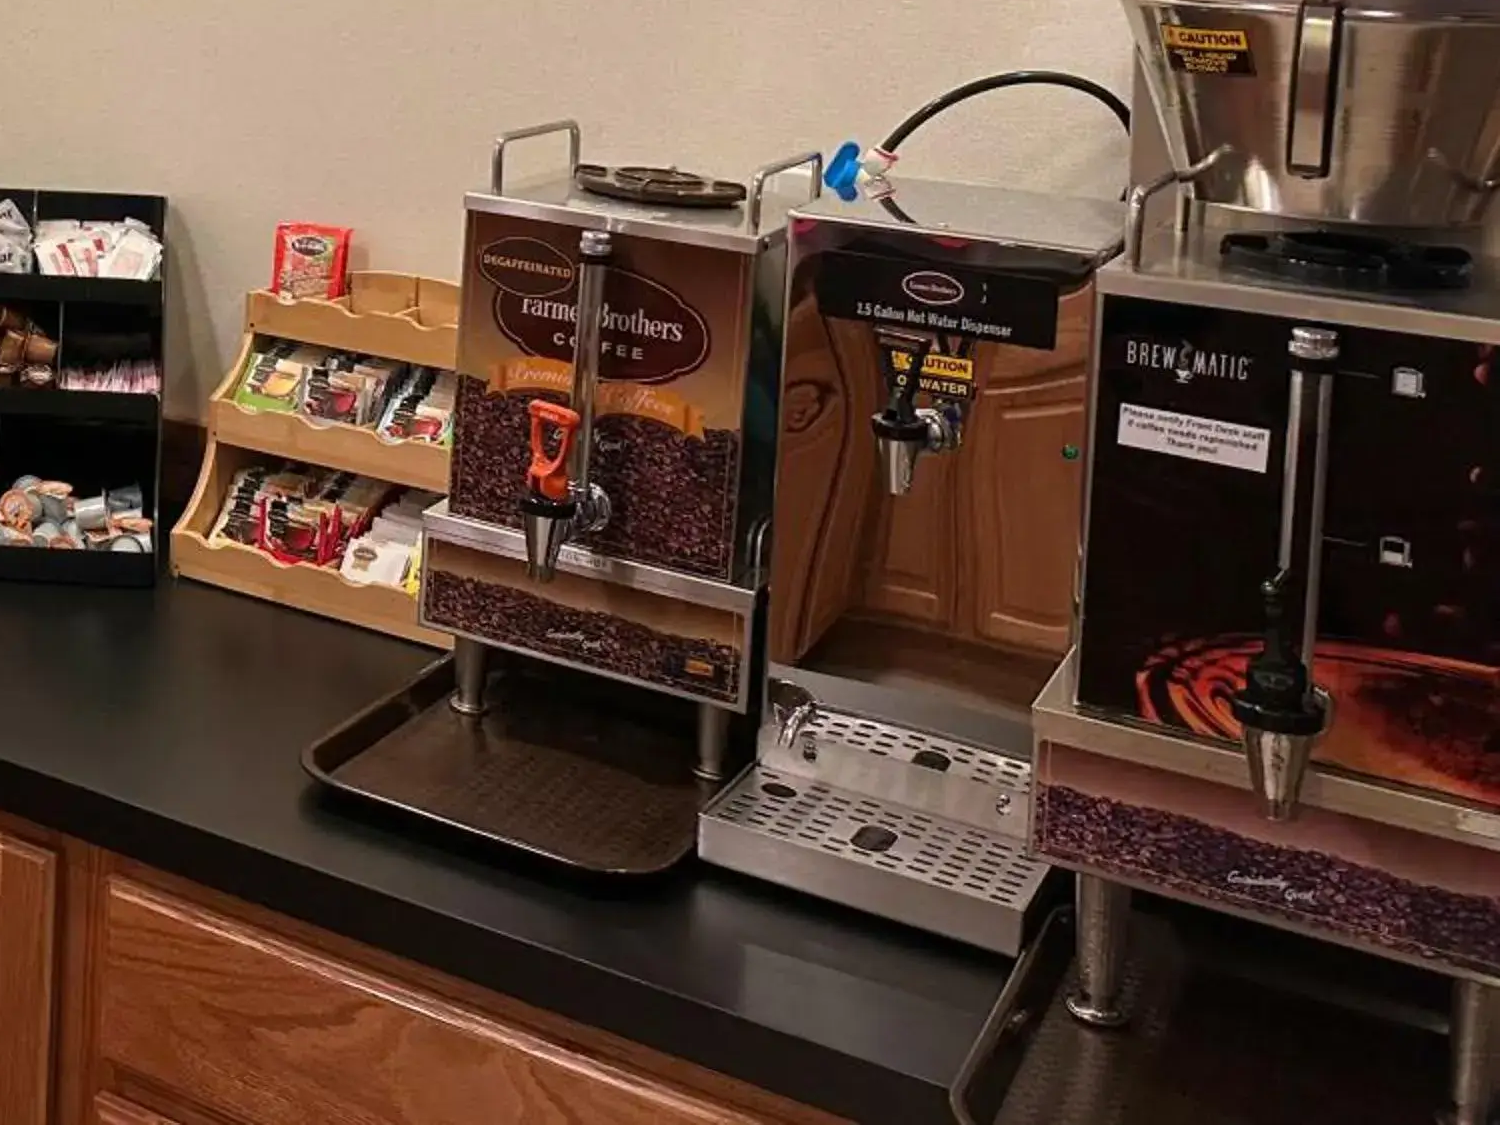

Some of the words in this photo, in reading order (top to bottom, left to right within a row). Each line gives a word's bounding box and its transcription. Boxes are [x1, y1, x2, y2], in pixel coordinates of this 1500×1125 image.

[1179, 32, 1241, 46] CAUTION
[483, 253, 572, 280] DECAFFEINATED
[597, 302, 684, 343] Brothers
[874, 304, 905, 322] Gallon
[907, 308, 927, 324] Hot
[928, 312, 959, 329] Water
[961, 317, 1013, 338] Dispenser
[553, 331, 645, 360] COFEE
[919, 378, 968, 395] WATER
[1123, 406, 1155, 420] Please
[1157, 414, 1184, 427] notify
[1185, 419, 1213, 433] Front
[1215, 424, 1241, 437] Desk
[1136, 421, 1165, 434] coffee
[1167, 428, 1197, 440] needs
[1199, 433, 1258, 451] replenished
[1166, 436, 1195, 450] Thank
